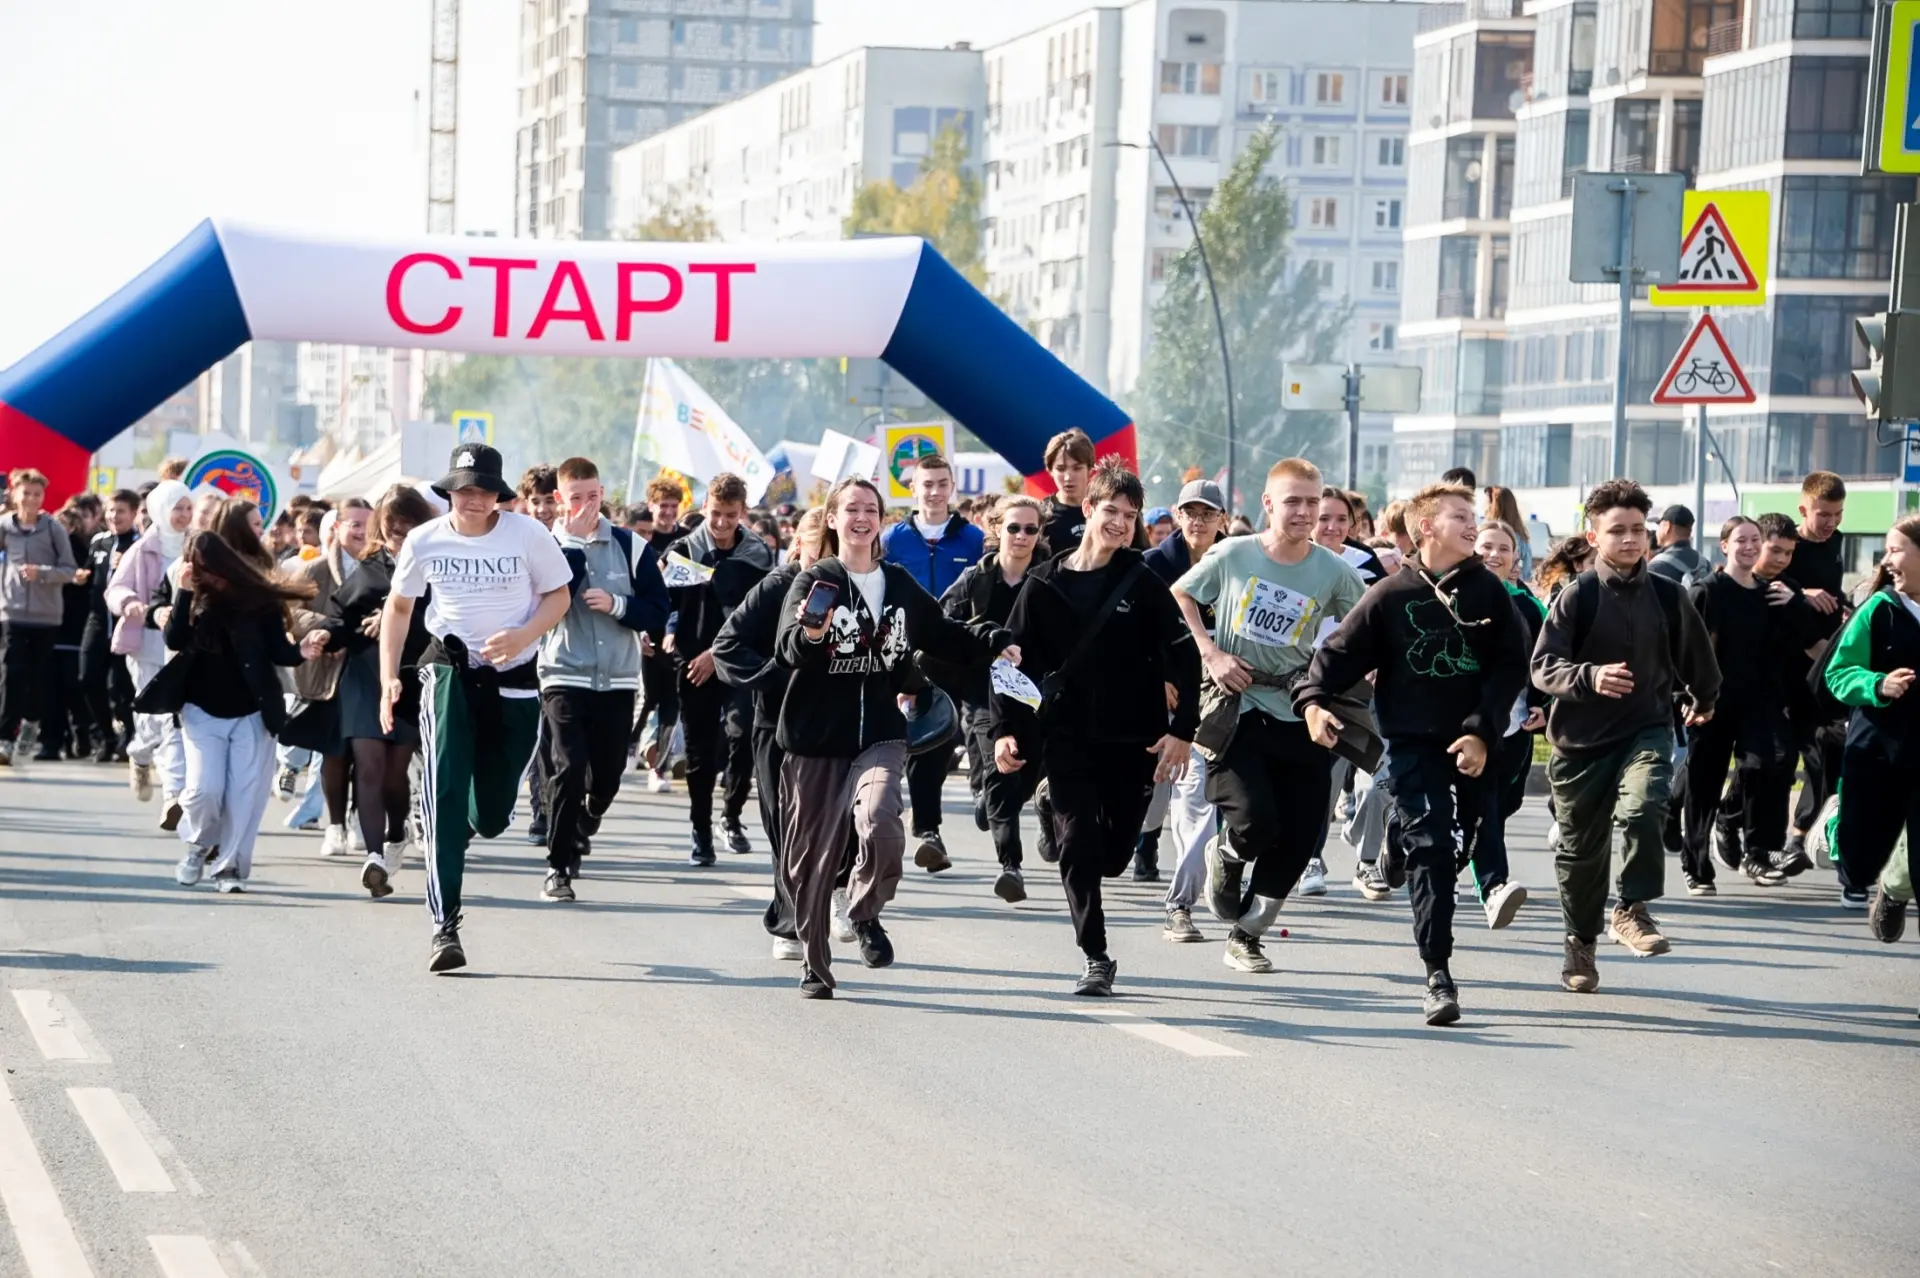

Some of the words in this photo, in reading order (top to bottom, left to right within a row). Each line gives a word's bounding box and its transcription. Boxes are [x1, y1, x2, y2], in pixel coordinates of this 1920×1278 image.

[386, 252, 756, 342] СТАРТ
[431, 556, 521, 575] DISTINCT
[1248, 605, 1295, 635] 10037
